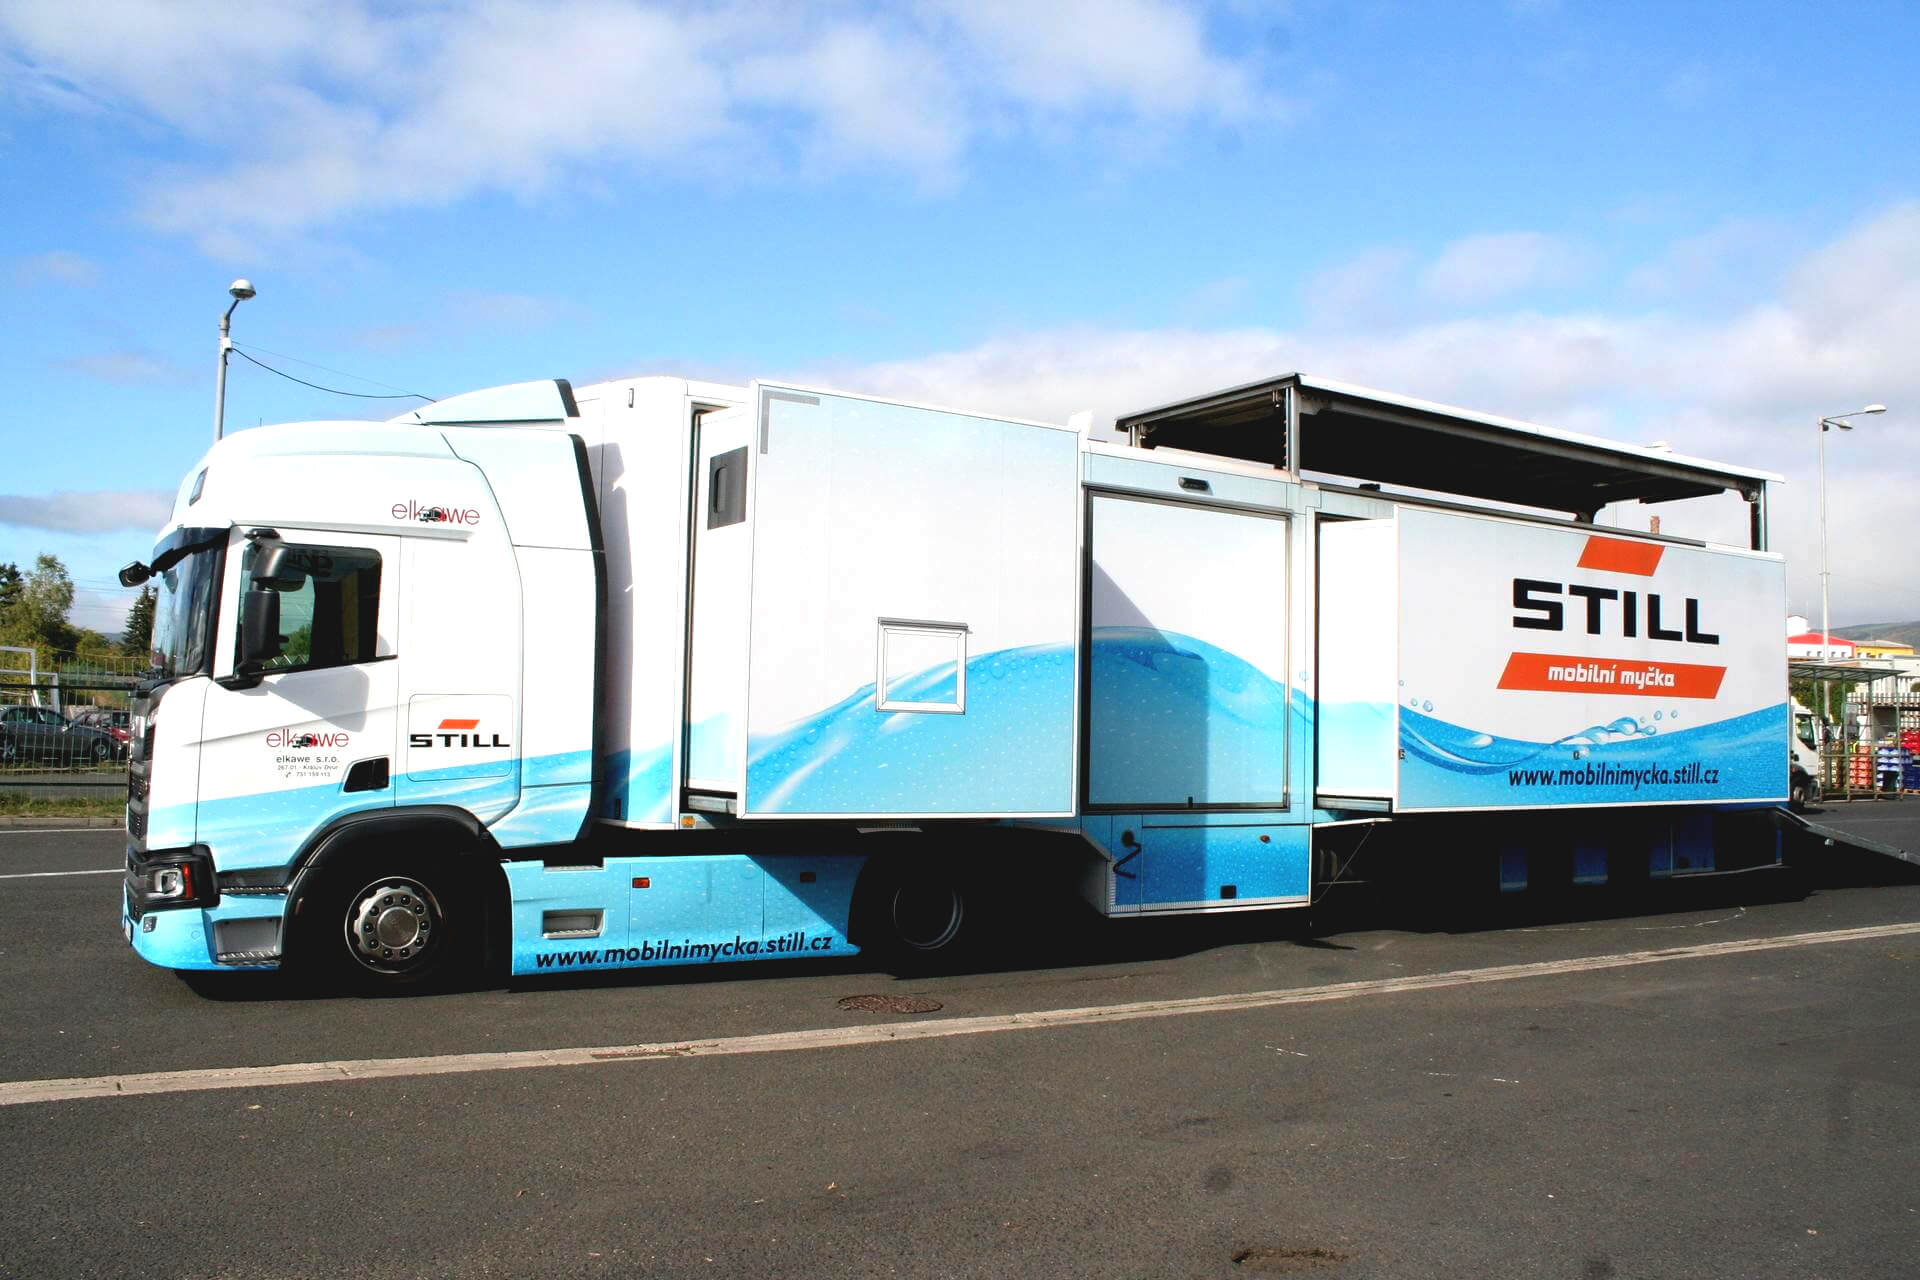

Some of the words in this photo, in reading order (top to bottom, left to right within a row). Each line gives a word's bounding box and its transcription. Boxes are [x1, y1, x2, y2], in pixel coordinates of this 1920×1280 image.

[1513, 577, 1719, 645] STILL
[1548, 663, 1616, 684] mobilní
[1620, 666, 1675, 690] myčka
[410, 733, 510, 748] STILL
[276, 755, 310, 763] elkawe
[1509, 762, 1720, 791] www.mobilnimycka.still.cz
[536, 932, 832, 968] www.mobilnimycka.still.cz
